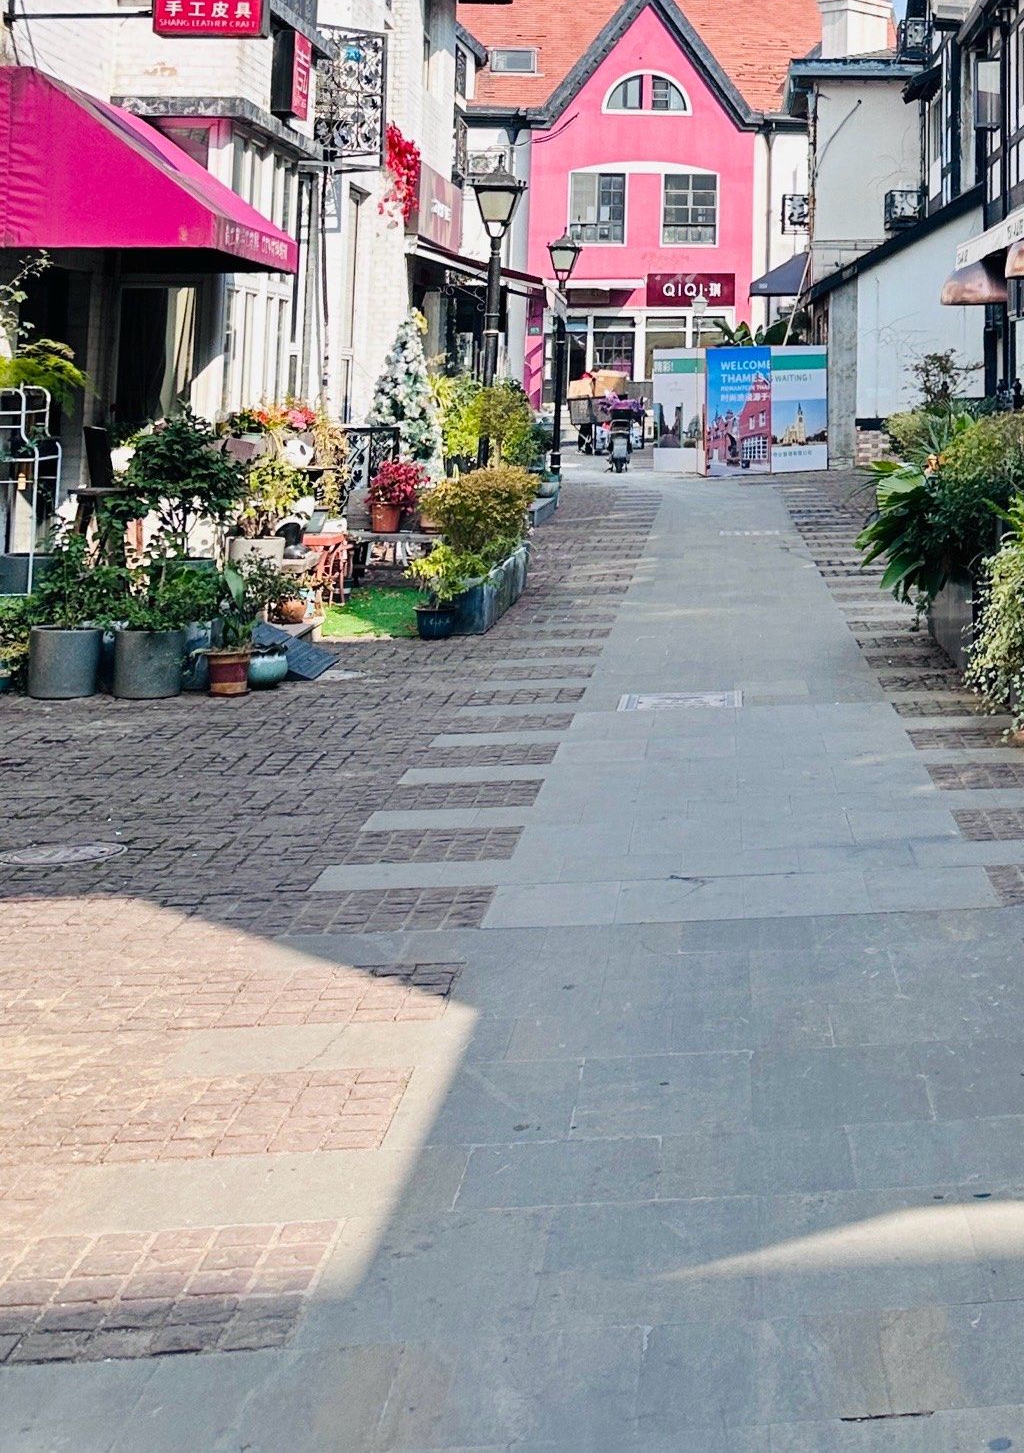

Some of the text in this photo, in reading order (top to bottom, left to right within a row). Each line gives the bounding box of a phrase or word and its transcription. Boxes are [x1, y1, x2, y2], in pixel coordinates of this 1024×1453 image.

[164, 0, 253, 19] 手工皮具
[159, 18, 190, 27] SHANG
[191, 19, 228, 27] LEATHER
[720, 360, 771, 371] WELCOME
